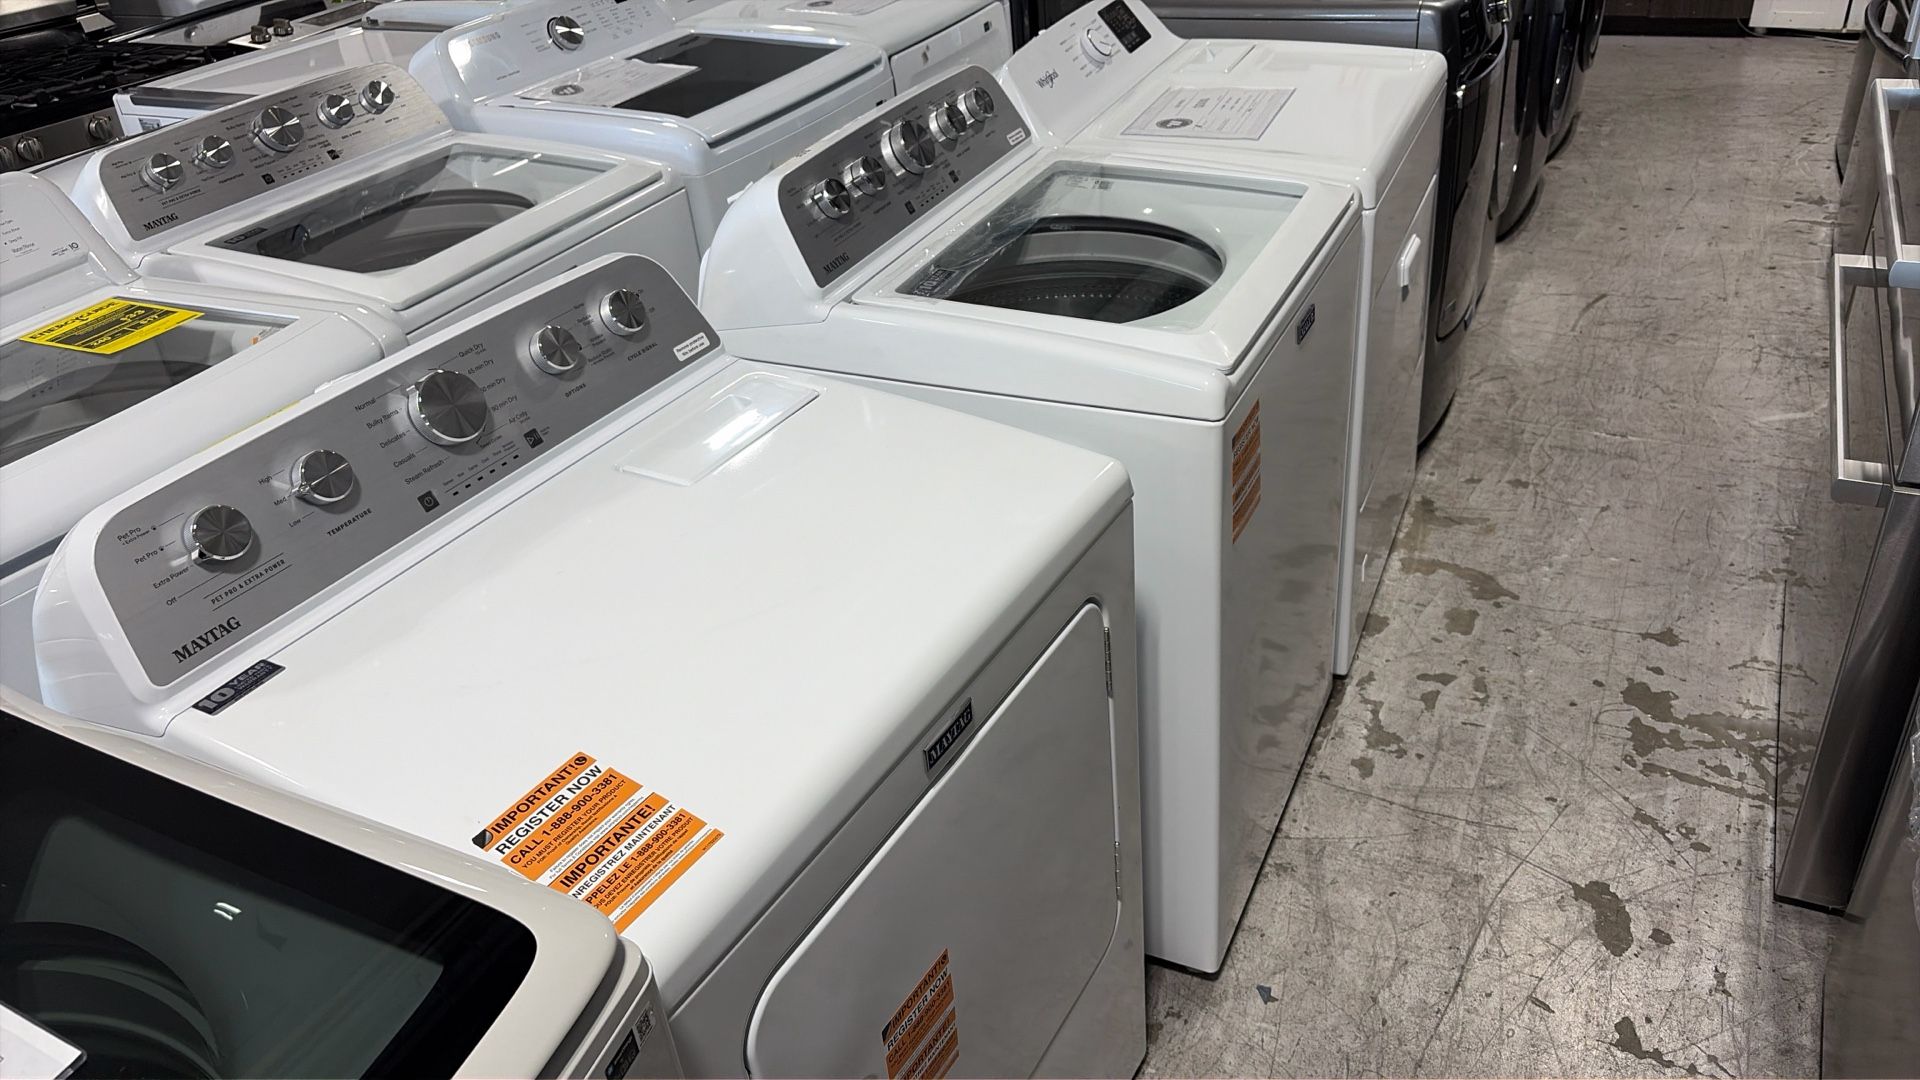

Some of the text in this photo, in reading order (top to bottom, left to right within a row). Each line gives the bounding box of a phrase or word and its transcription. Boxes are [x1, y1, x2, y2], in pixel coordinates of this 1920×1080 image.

[143, 213, 179, 231] MAYTAG
[823, 252, 850, 274] MAYTAG
[472, 341, 484, 351] Dry
[627, 350, 642, 361] CYCLE
[474, 363, 484, 371] min
[483, 358, 494, 368] Dry
[487, 381, 497, 389] min
[495, 376, 506, 385] Dry
[564, 382, 587, 398] OPTIONS
[354, 396, 376, 411] Normal
[507, 394, 518, 403] Dry
[366, 408, 399, 429] Bulky Items
[508, 416, 516, 424] Air
[379, 430, 406, 448] Delicates
[392, 451, 416, 468] Casuals
[258, 475, 273, 486] High
[404, 458, 444, 485] Steam Refresh
[273, 496, 287, 506] Med
[117, 525, 141, 541] Pet Pro
[288, 517, 301, 528] Low
[327, 508, 373, 537] TEMPERATURE
[134, 548, 158, 565] Pet Pro
[153, 565, 190, 589] Extra Power
[211, 594, 224, 604] PET
[224, 585, 238, 597] PRO
[243, 570, 264, 585] EXTRA
[264, 558, 285, 573] POWER
[165, 595, 178, 606] Off
[171, 617, 241, 663] MAYTAG
[194, 663, 265, 711] 10 YEAR
[930, 707, 971, 765] MAYTAG
[491, 762, 579, 833] IMPORTANT!
[495, 765, 603, 853] REGISTER NOW
[508, 772, 618, 864] CALL 1-888-900-3381
[522, 779, 626, 868] YOU MUST REGISTER YOUR PRODUCT
[559, 803, 656, 886] IMPORTANTE!
[571, 849, 627, 897] NREGISTREZ
[624, 805, 676, 850] MAINTENANT
[584, 871, 621, 903] PPELEZ
[617, 861, 633, 873] LE
[629, 812, 687, 862] 1-888-900-3381
[593, 817, 694, 908] OUS DEVEZ ENREGISTRER VOTRE PRODUIT
[888, 968, 947, 1050] REGISTER NOW
